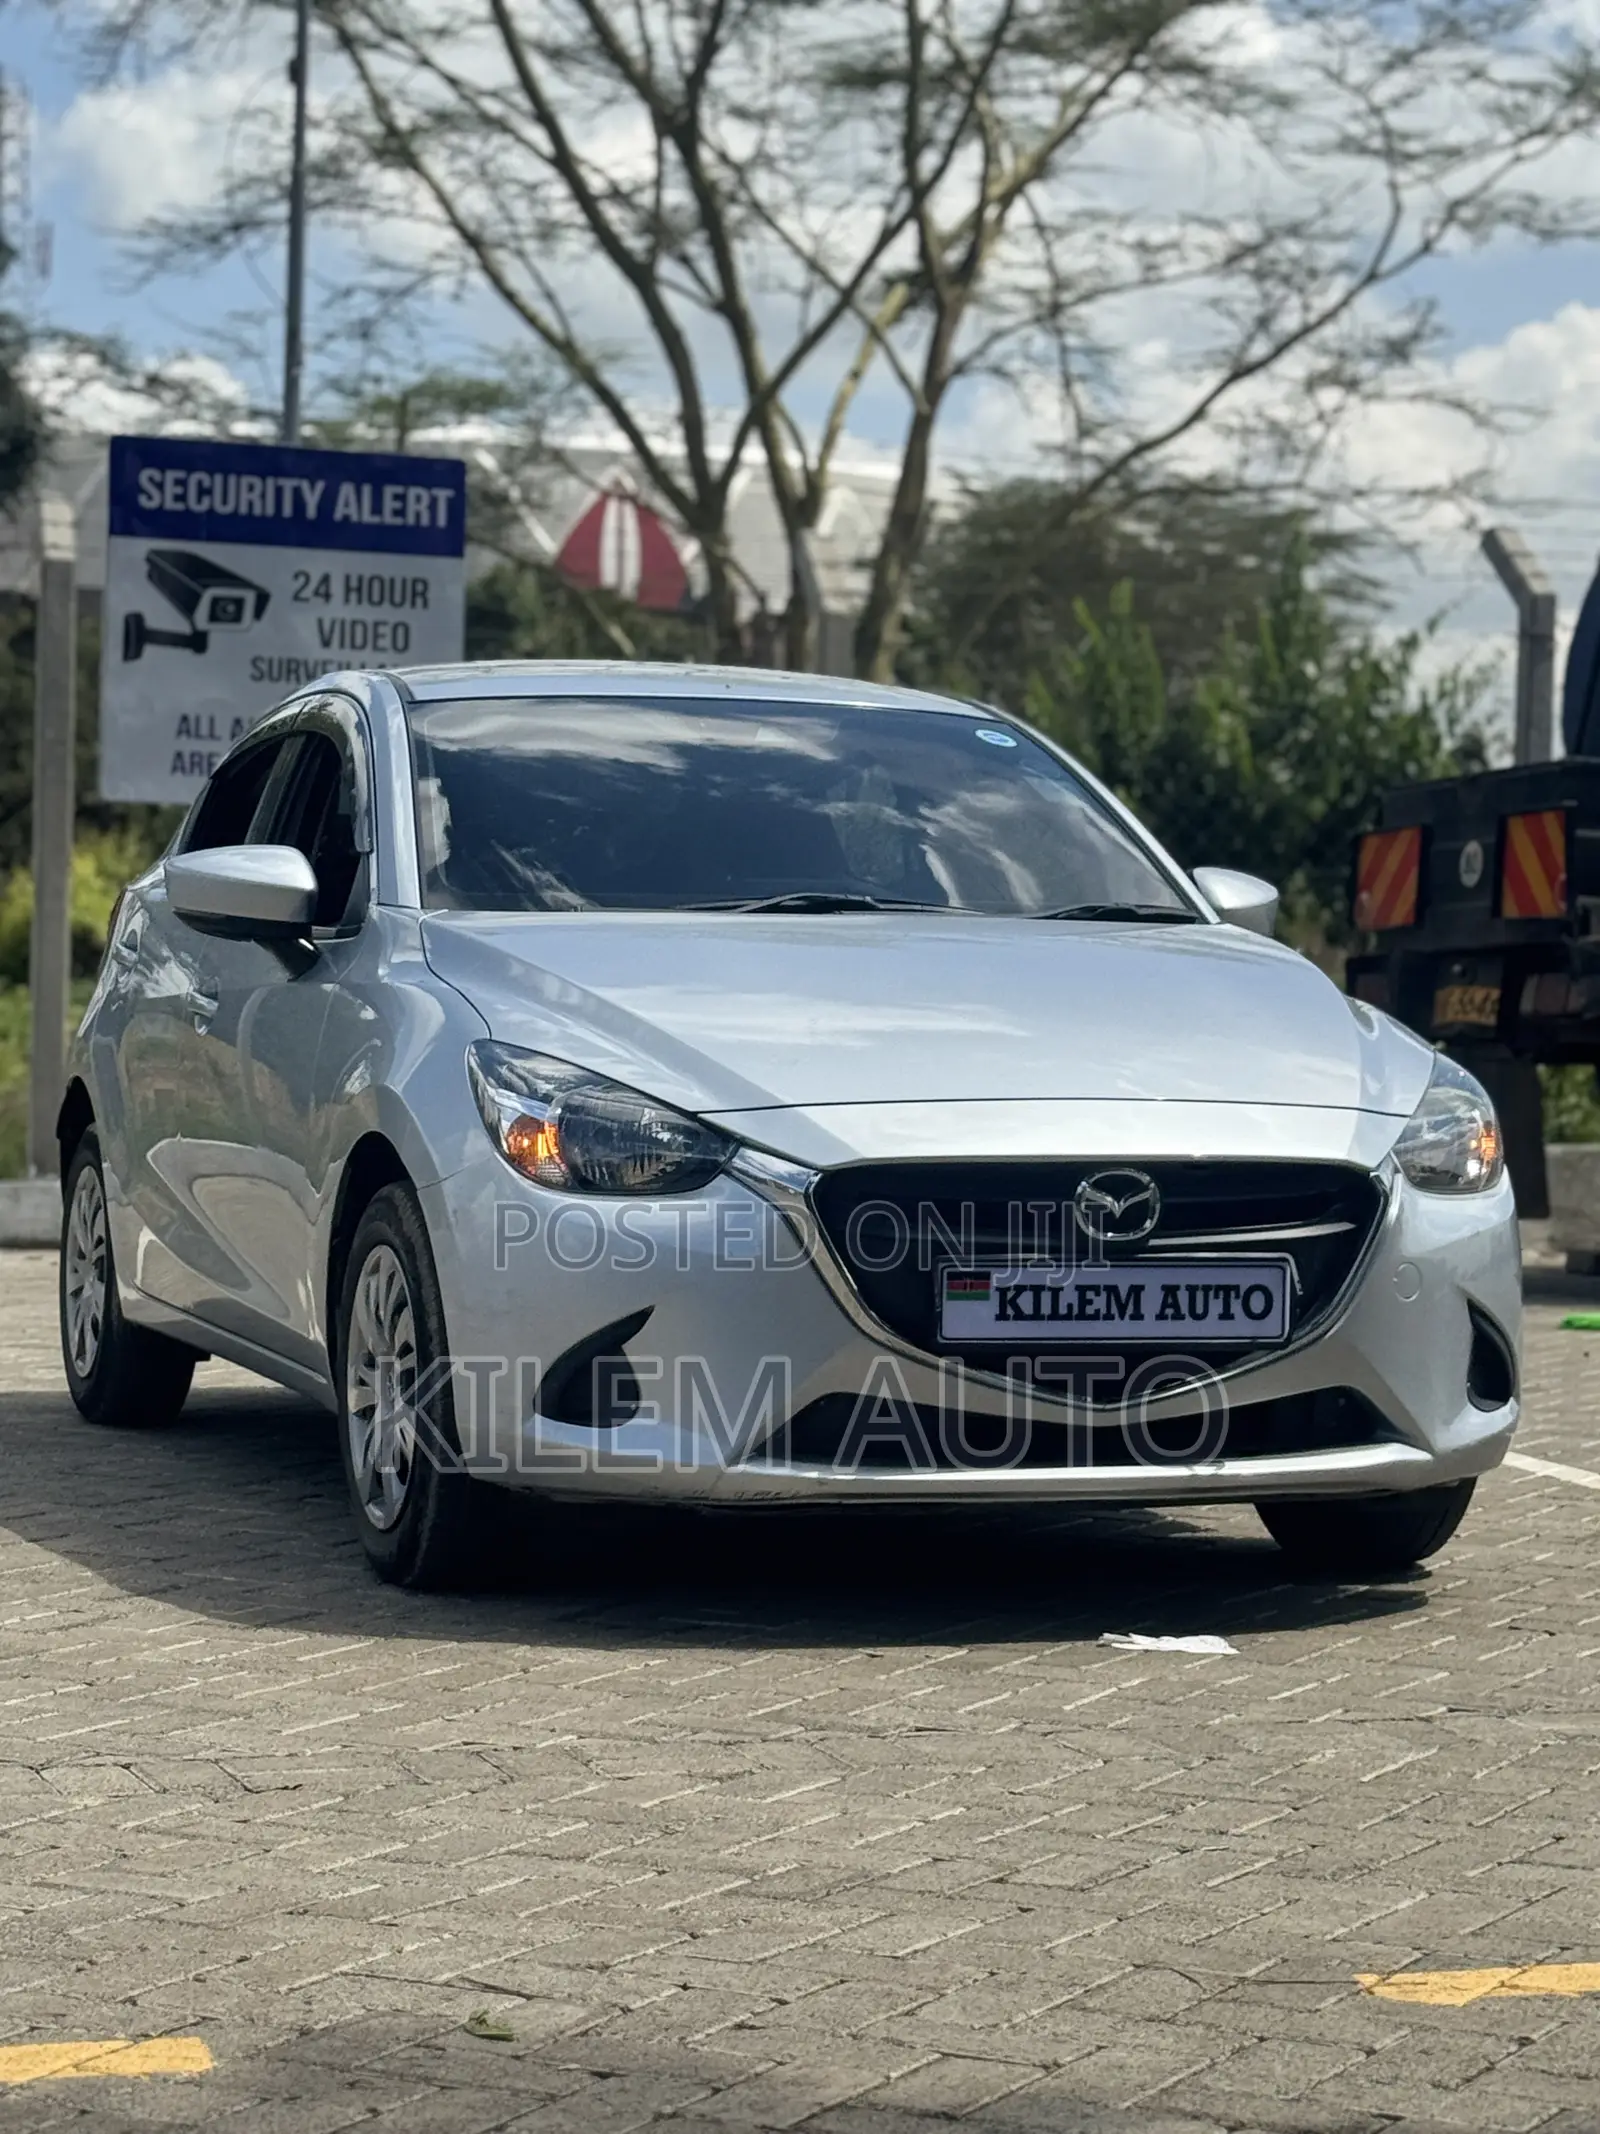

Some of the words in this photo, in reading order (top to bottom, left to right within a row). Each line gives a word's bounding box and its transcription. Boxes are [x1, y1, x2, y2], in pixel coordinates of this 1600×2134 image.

[138, 467, 325, 520] SECURITY
[332, 481, 455, 528] ALERT
[291, 570, 333, 603] 24
[344, 574, 429, 610] HOUR
[317, 617, 411, 654] VIDEO
[176, 713, 221, 741] ALL
[994, 1284, 1146, 1322] KILEM
[1155, 1283, 1274, 1323] AUTO
